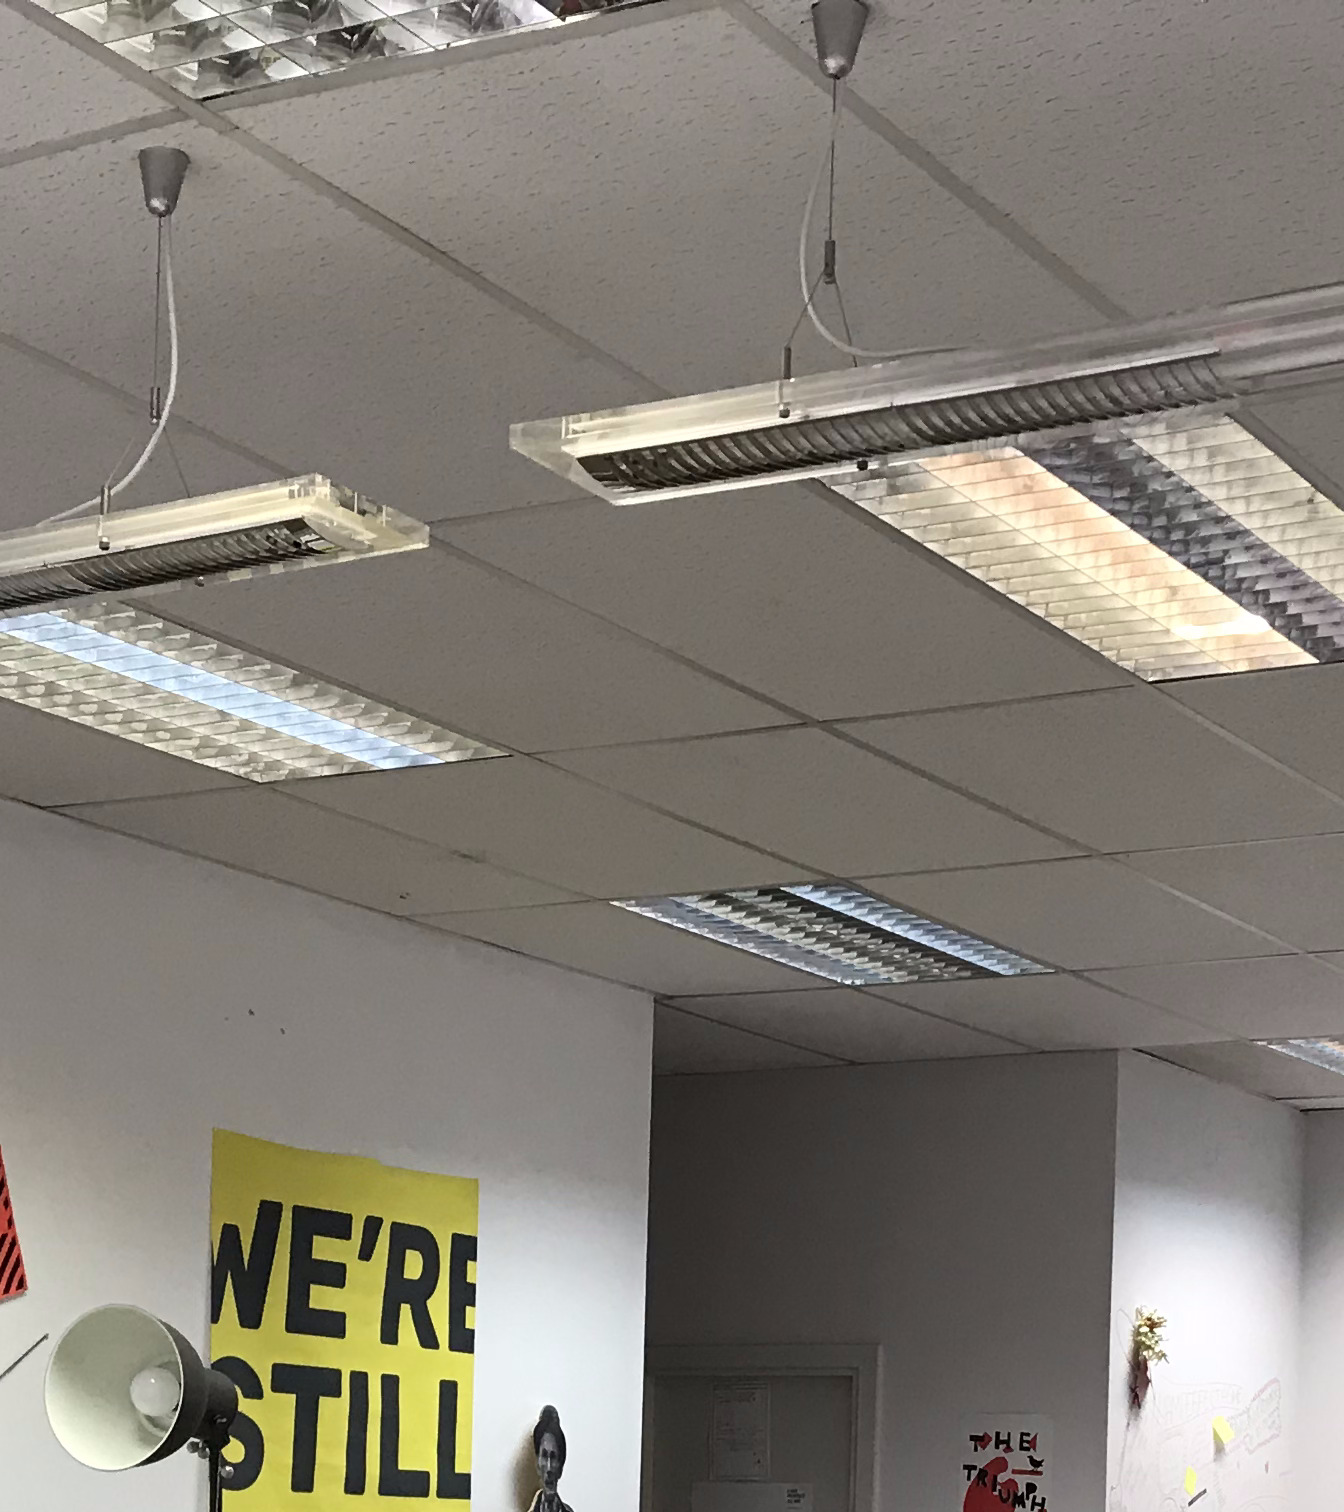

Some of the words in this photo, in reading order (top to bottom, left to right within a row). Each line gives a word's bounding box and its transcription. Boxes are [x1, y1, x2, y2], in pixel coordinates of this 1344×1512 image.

[210, 1355, 471, 1500] STILL
[969, 1431, 1031, 1452] THE
[962, 1464, 1046, 1512] TRIUMPH
